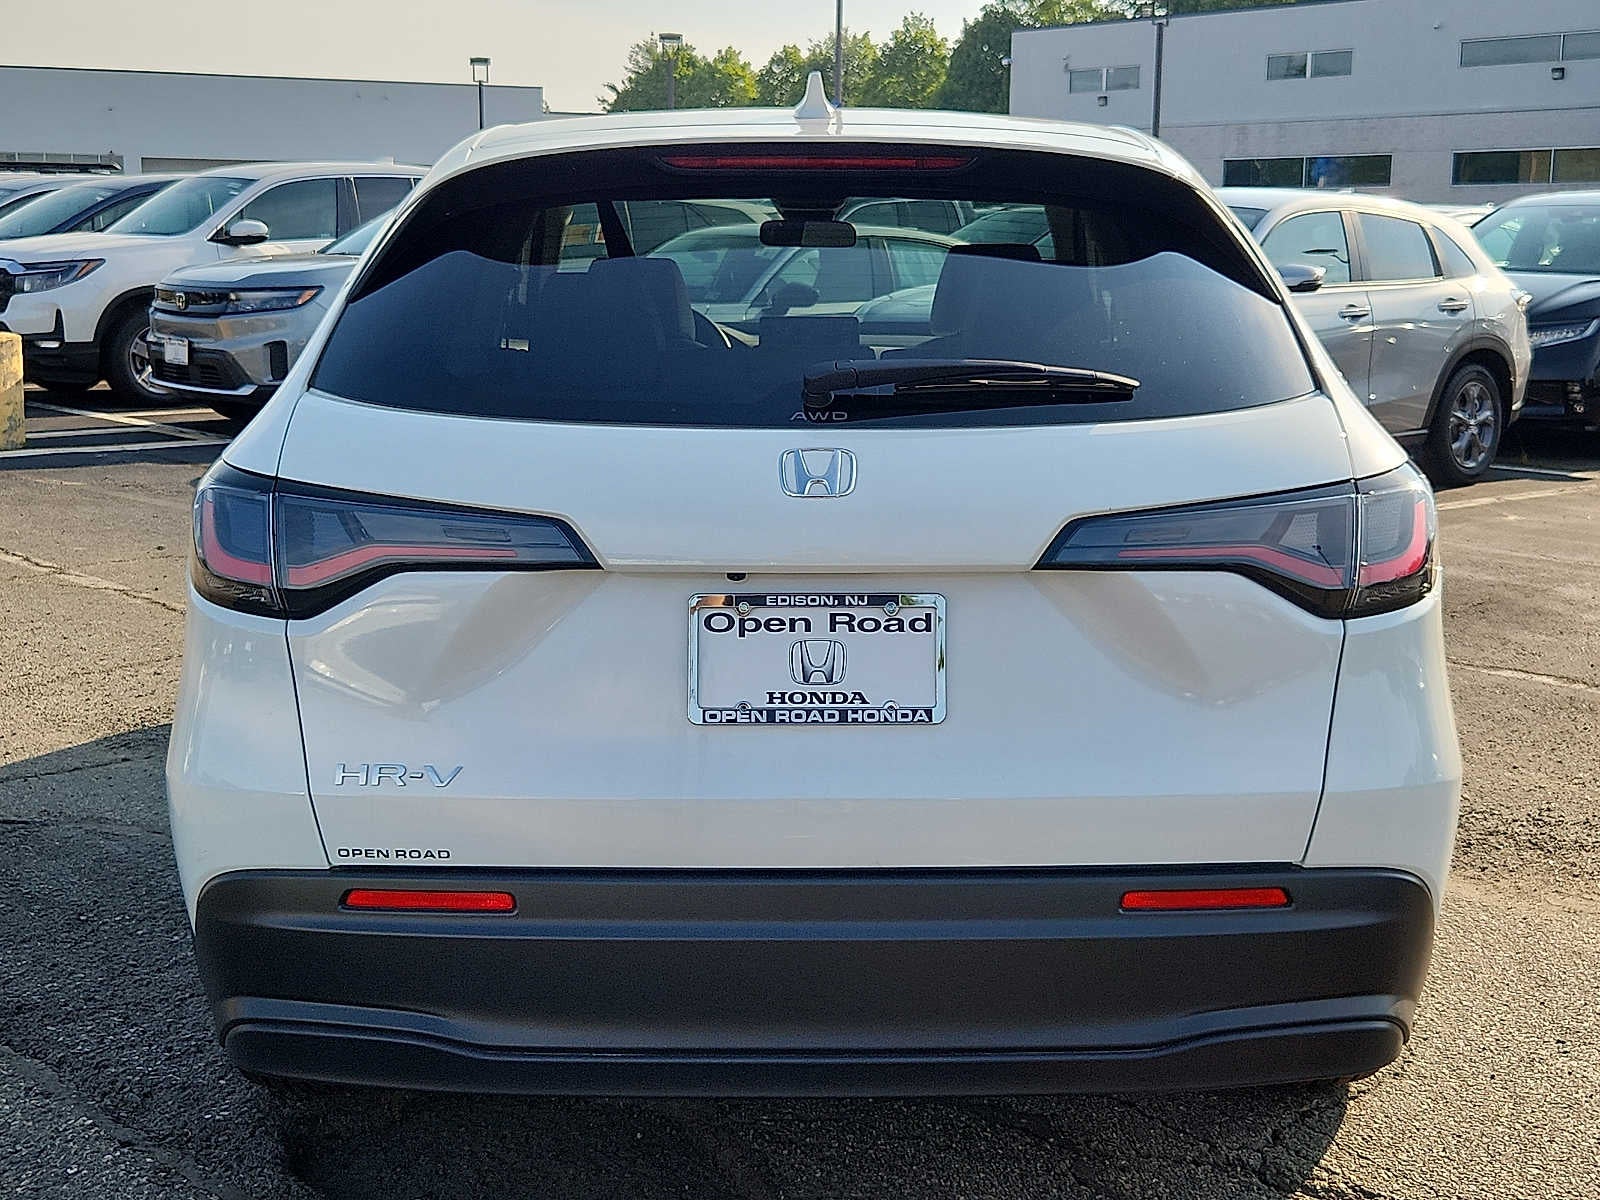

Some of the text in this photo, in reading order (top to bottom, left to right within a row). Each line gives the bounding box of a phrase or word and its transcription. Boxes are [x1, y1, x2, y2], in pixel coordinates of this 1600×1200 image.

[789, 411, 848, 421] AWD
[766, 595, 868, 607] EDISON, NJ
[703, 612, 932, 638] Open Road
[766, 691, 870, 705] HONDA
[704, 709, 929, 723] OPEN ROAD HONDA
[335, 763, 464, 787] HR-V
[337, 848, 451, 859] OPEN ROAD
